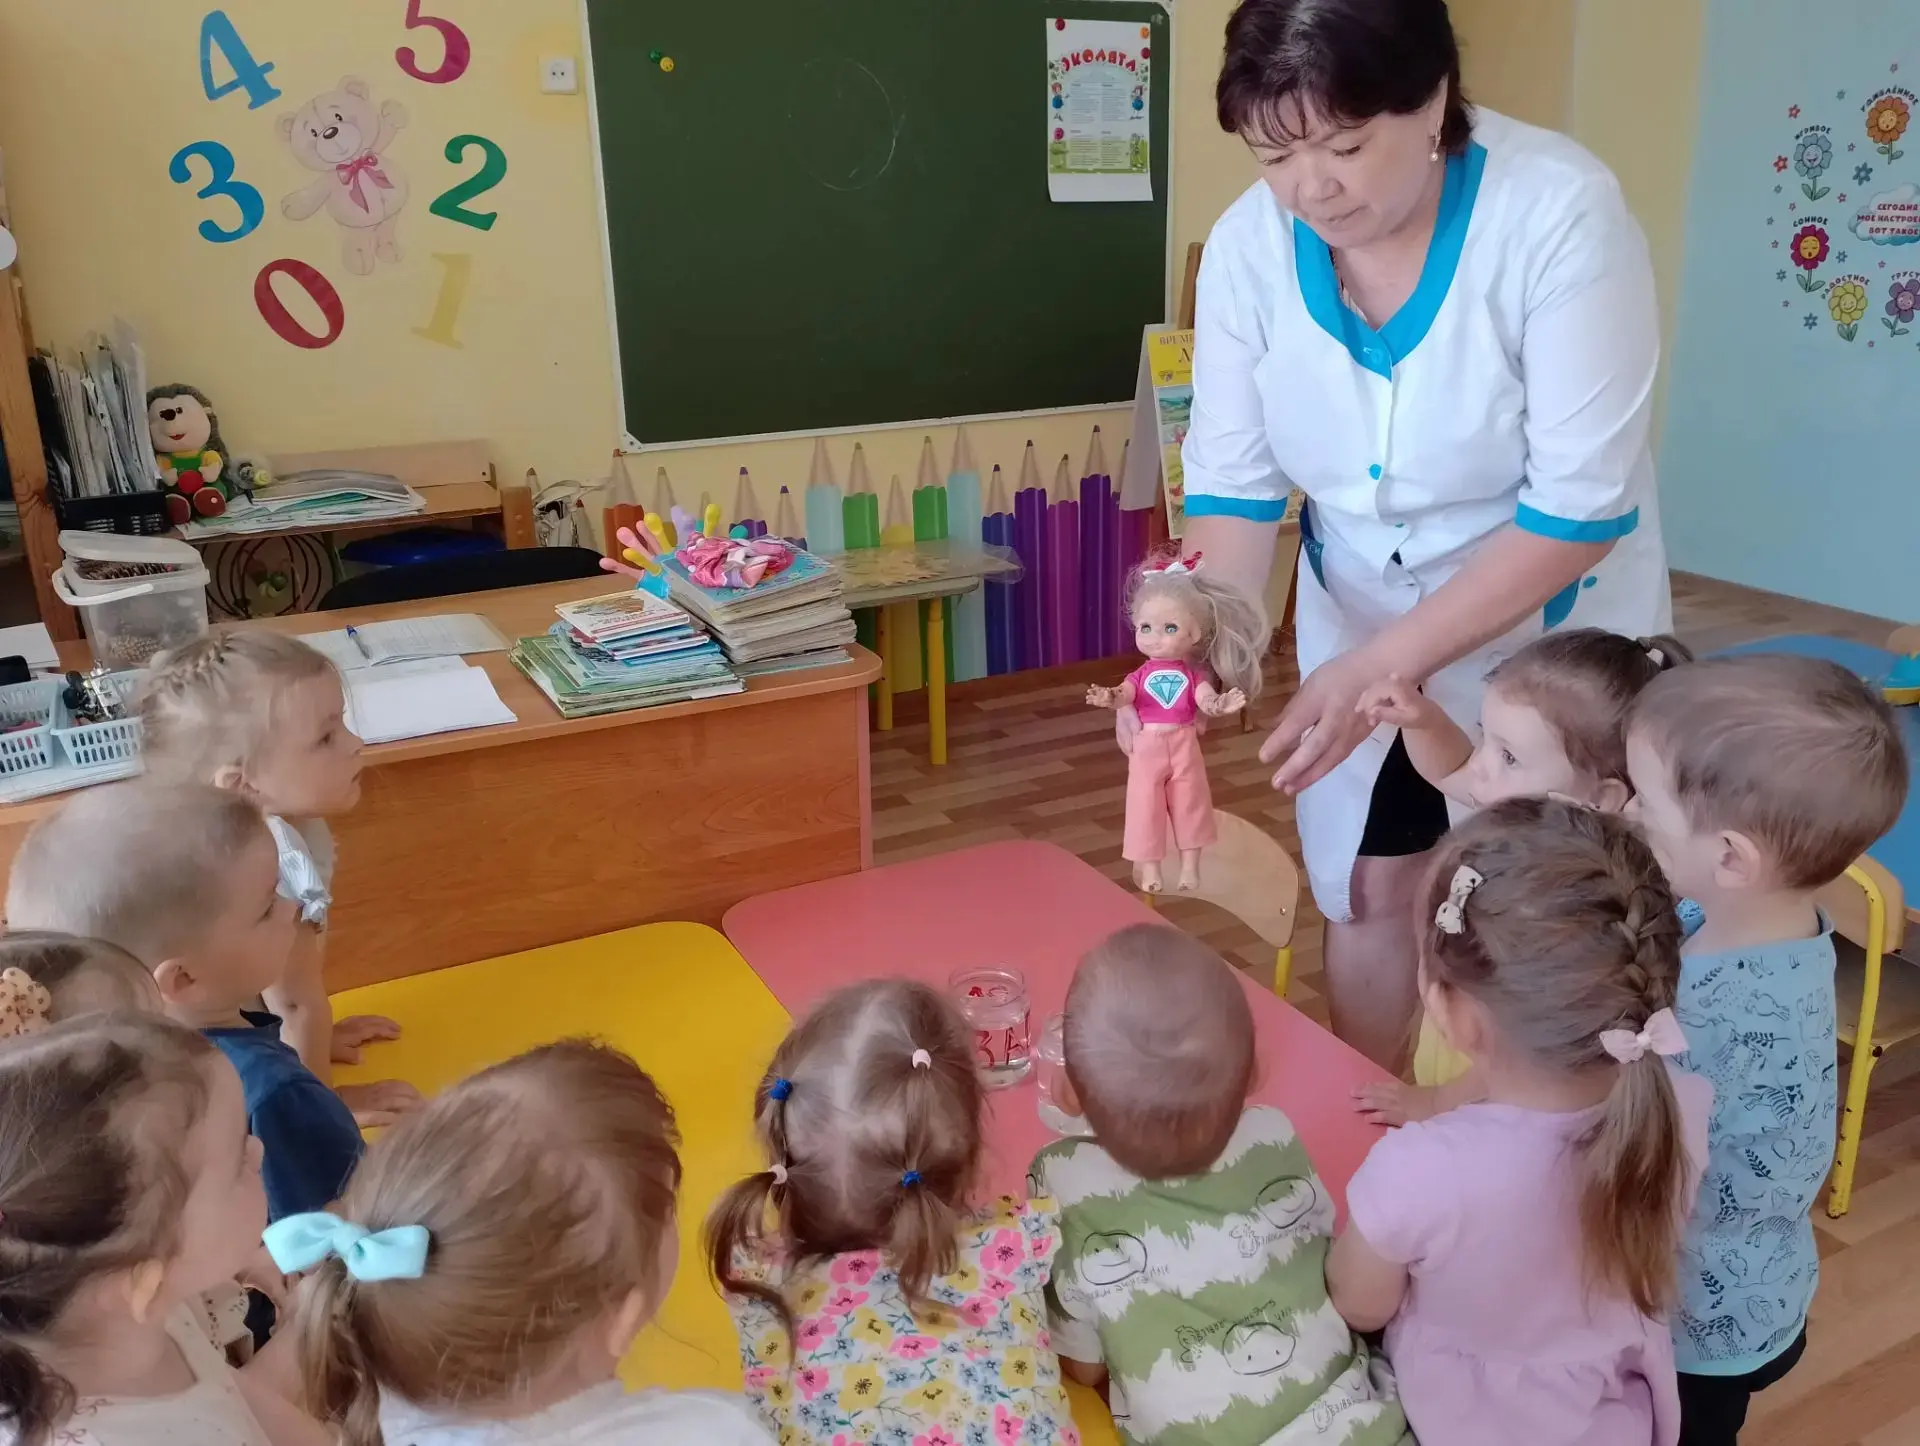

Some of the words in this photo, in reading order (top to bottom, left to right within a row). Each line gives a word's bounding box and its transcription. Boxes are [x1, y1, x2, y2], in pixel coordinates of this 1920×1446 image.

[200, 10, 282, 110] 4
[395, 0, 471, 84] 5
[1061, 48, 1136, 72] ЭКОЛЯТА
[169, 140, 265, 244] 3
[429, 134, 508, 231] 2
[1793, 216, 1829, 227] СОННОЕ
[1877, 202, 1919, 211] СЕГОДНЯ
[1877, 214, 1920, 223] НАСТРОЕ
[253, 258, 345, 349] 0
[411, 252, 473, 349] 1
[1891, 270, 1920, 281] ГРУСТ
